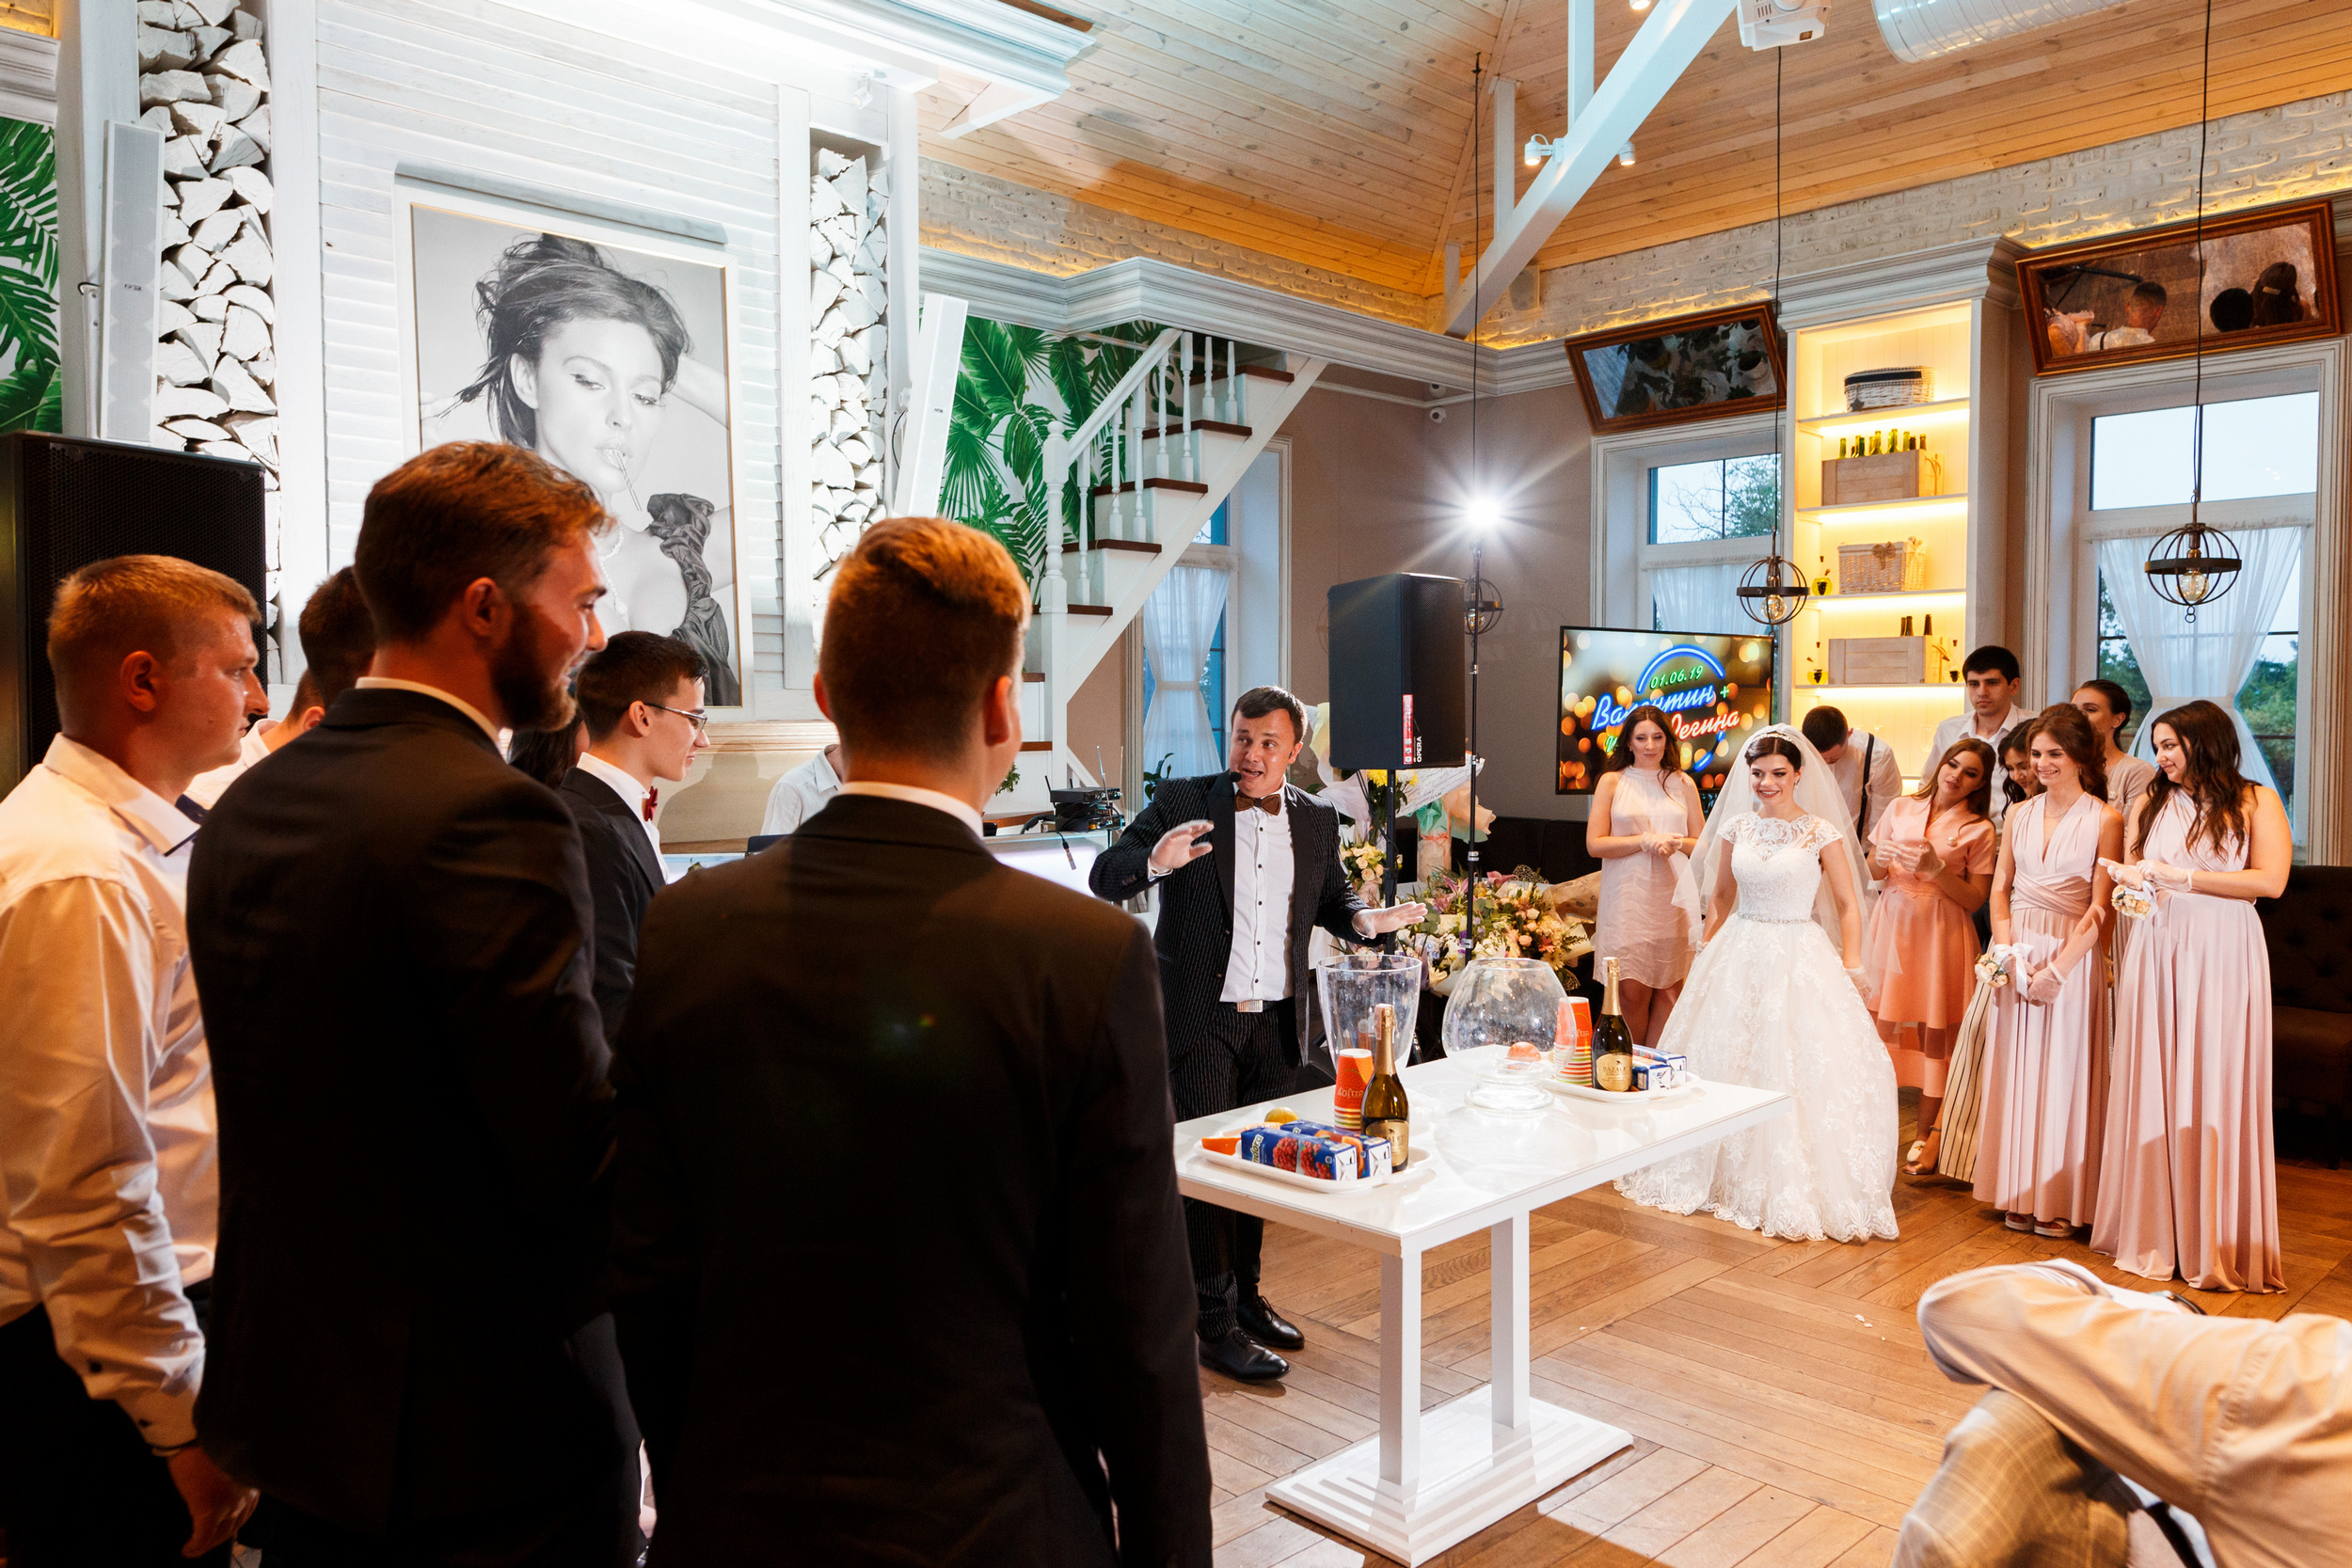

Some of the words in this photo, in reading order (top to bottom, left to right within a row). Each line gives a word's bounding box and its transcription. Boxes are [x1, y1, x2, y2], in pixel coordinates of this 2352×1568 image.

[1649, 665, 1704, 690] 01.06.19
[1592, 685, 1714, 730] Вантин
[1251, 1134, 1263, 1164] ndora
